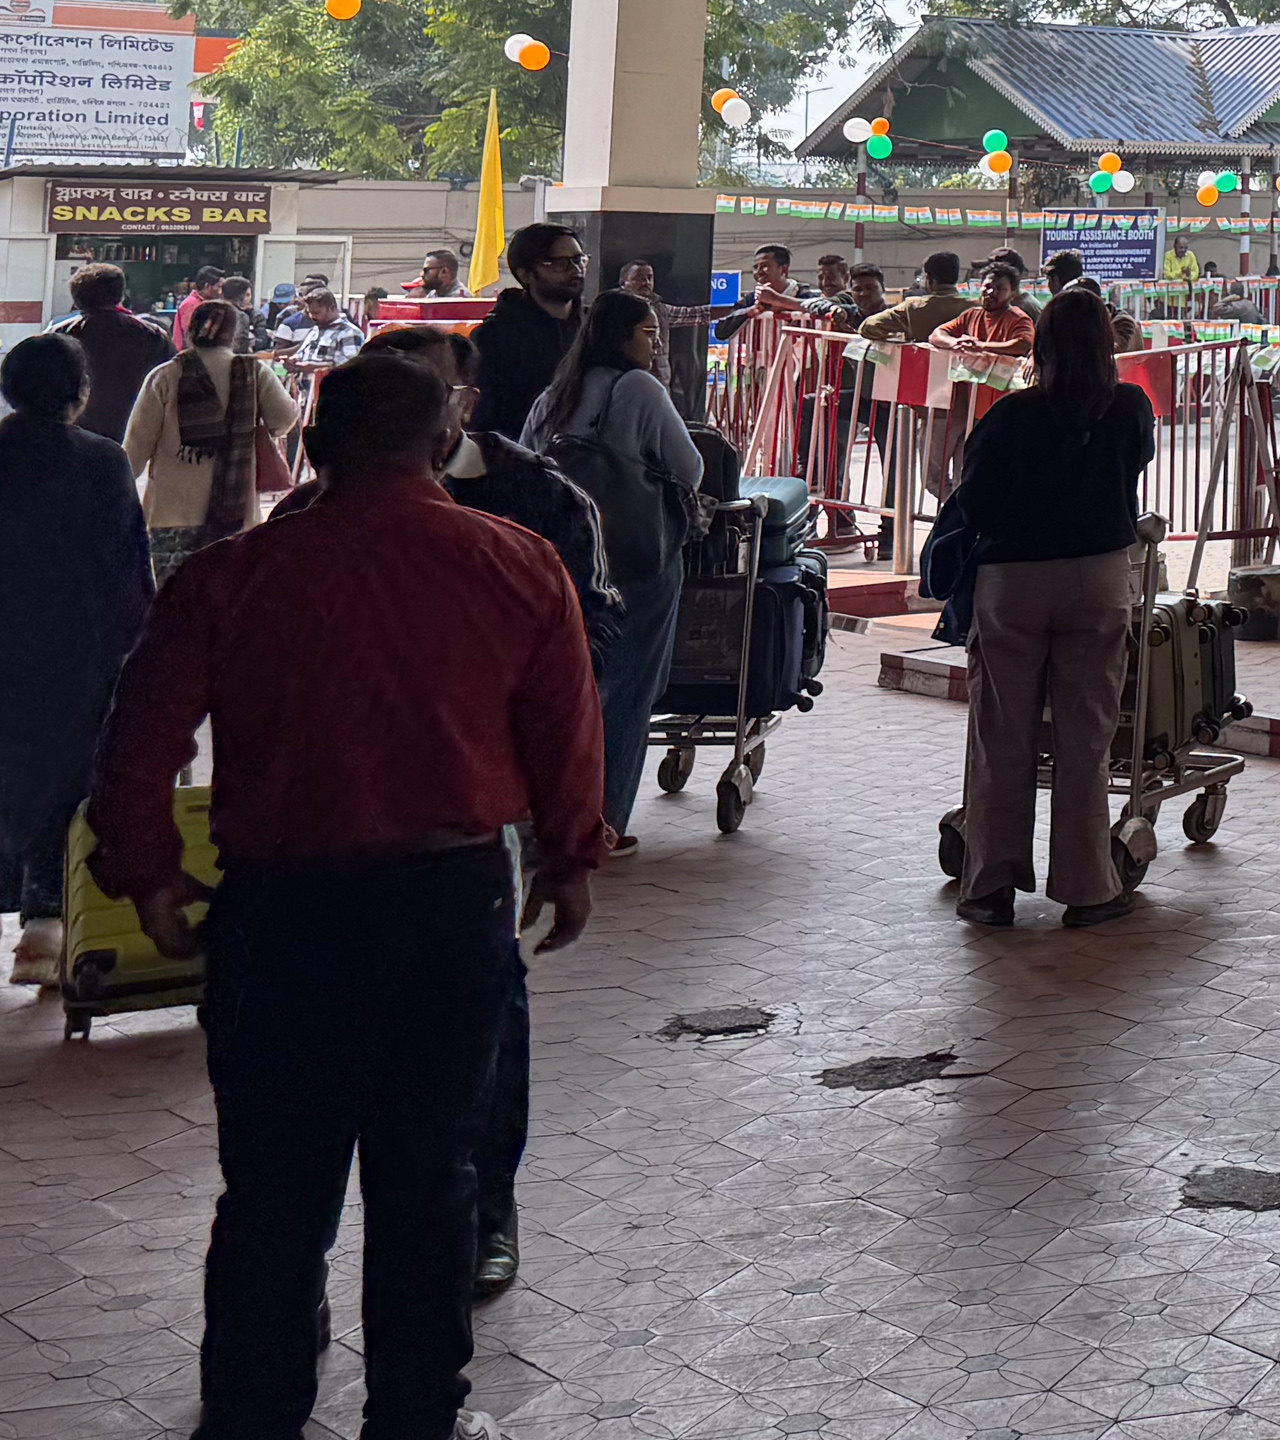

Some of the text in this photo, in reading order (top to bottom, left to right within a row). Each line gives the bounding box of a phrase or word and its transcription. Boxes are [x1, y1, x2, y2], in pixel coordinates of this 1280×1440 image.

[99, 34, 175, 53] লিমিটেড
[100, 72, 173, 91] लिमिटेड
[95, 111, 169, 126] Limited
[120, 188, 154, 201] বার
[234, 190, 267, 203] बार
[52, 205, 268, 223] SNACKS BAR
[1046, 229, 1155, 241] TOURIST ASSISTANCE BOOTH
